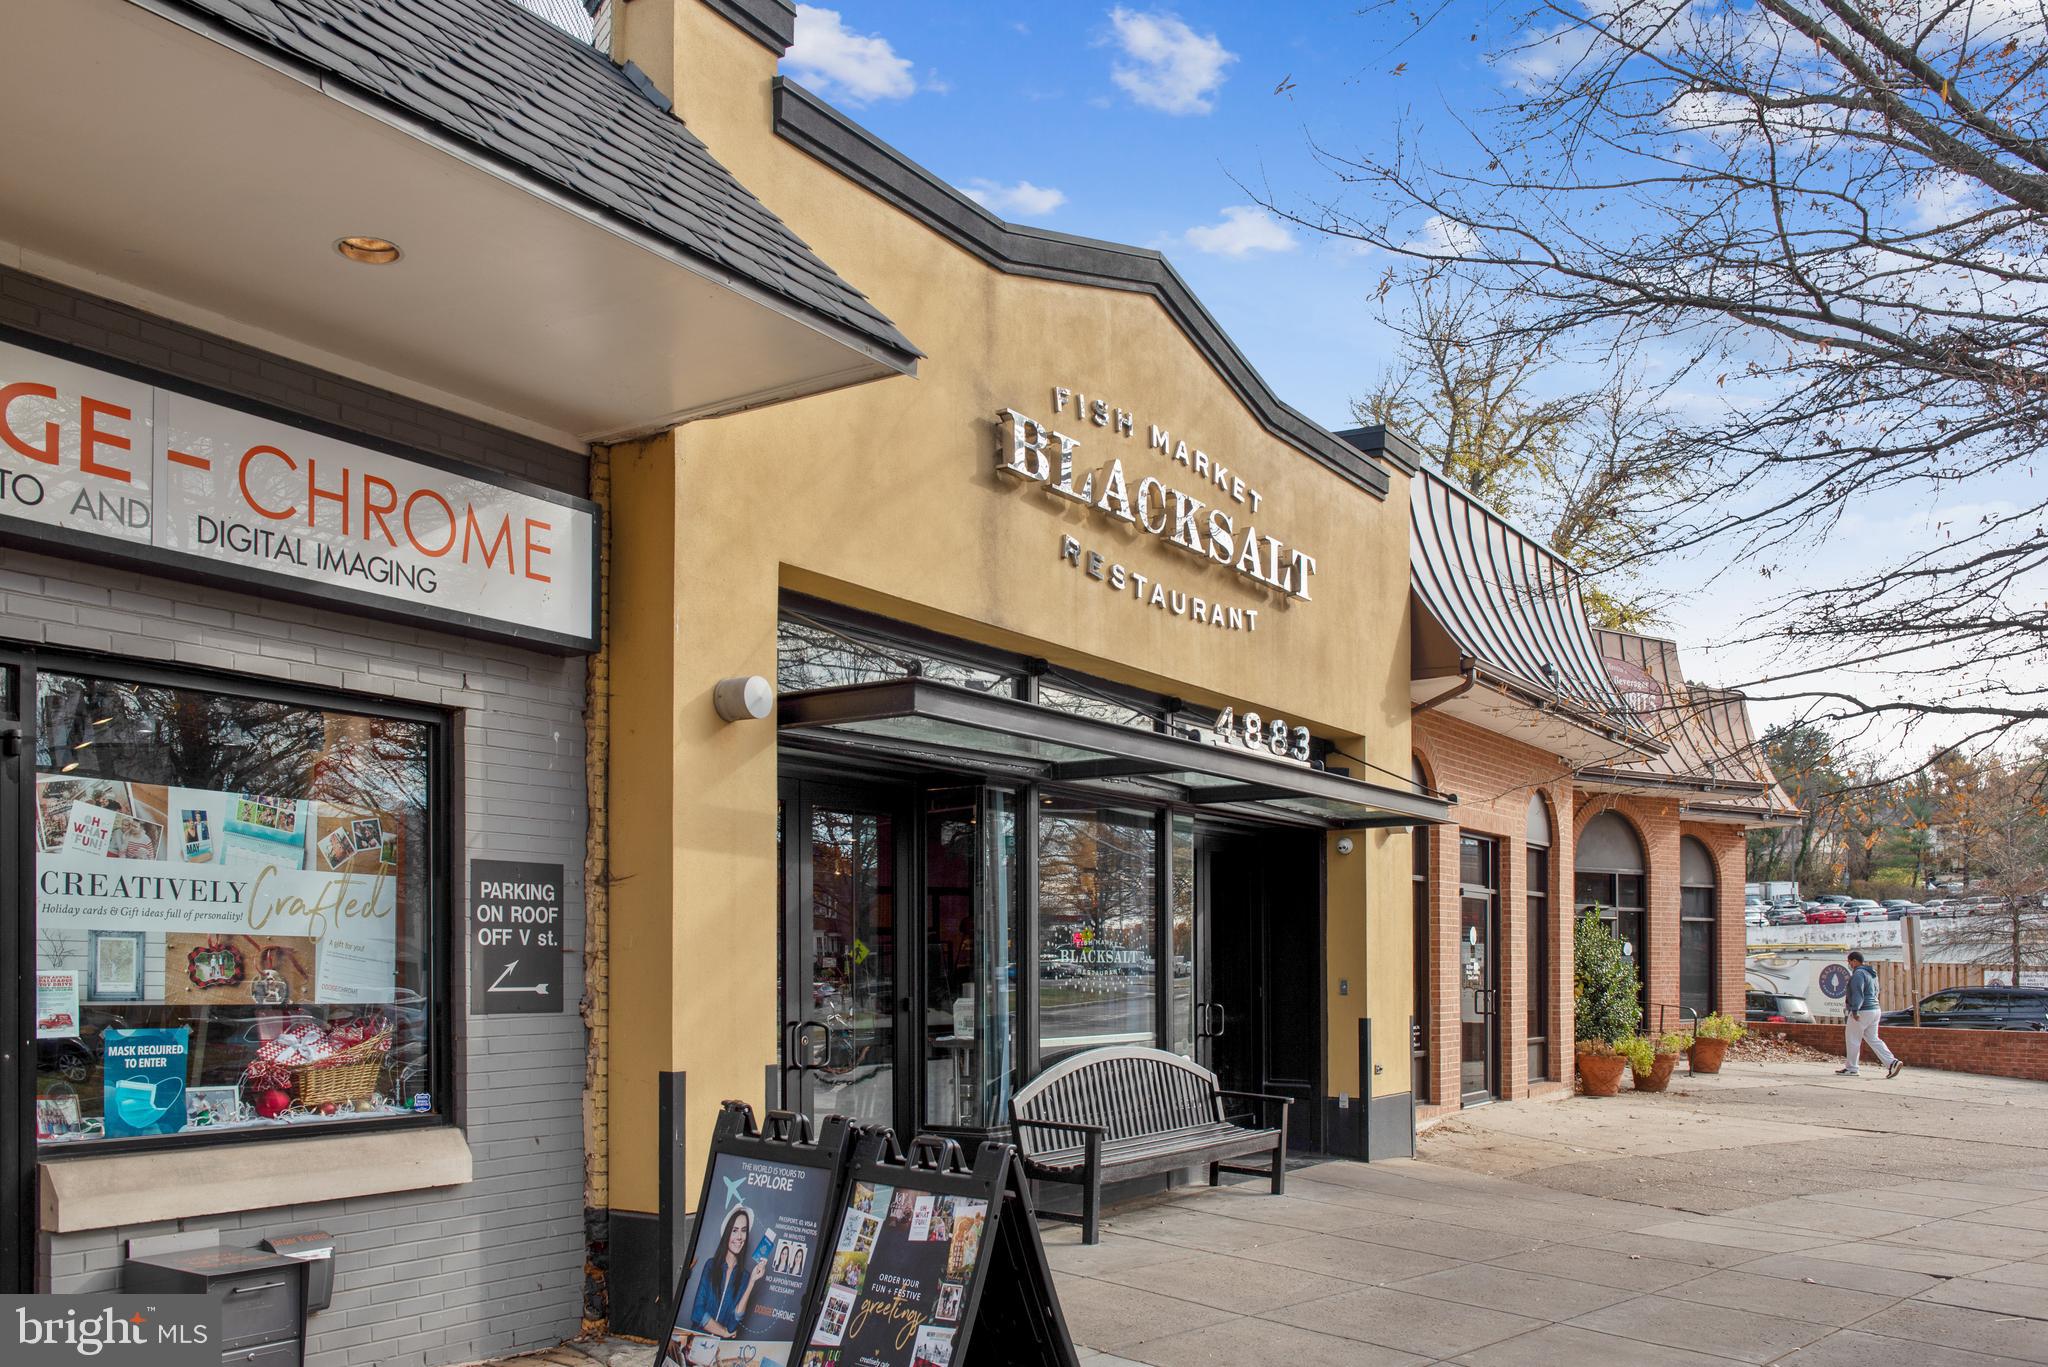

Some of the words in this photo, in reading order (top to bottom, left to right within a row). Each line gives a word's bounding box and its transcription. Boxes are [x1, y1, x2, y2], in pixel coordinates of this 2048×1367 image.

[1054, 386, 1133, 437] FISH
[1150, 424, 1263, 513] MARKET
[70, 487, 152, 529] AND
[996, 407, 1316, 602] BLACKSALT
[239, 445, 551, 583] CHROME
[198, 515, 307, 566] DIGITAL
[317, 542, 437, 594] IMAGING
[1061, 534, 1258, 631] RESTAURANT
[1213, 706, 1310, 761] 4883
[84, 815, 100, 827] OH
[73, 822, 108, 839] WHAT
[74, 833, 103, 850] FUN!
[186, 843, 200, 855] MAY
[40, 870, 248, 904] CREATIVELY
[248, 856, 392, 944] Crafted
[480, 881, 555, 902] PARKING
[41, 903, 80, 917] Holiday
[82, 905, 107, 916] cards
[110, 907, 118, 916] &
[120, 906, 139, 920] Gift
[142, 907, 164, 918] ideas
[165, 908, 181, 921] full
[183, 909, 193, 921] of
[194, 910, 243, 922] personality!
[477, 905, 503, 923] ON
[511, 906, 559, 924] ROOF
[478, 928, 512, 946] OFF
[519, 929, 531, 946] V
[537, 930, 558, 946] st.
[1060, 949, 1138, 964] BLACKSALT
[1077, 967, 1122, 976] RESTAURANT
[108, 1045, 136, 1056] MASK
[137, 1044, 184, 1056] REQUIRED
[124, 1058, 137, 1069] TO
[138, 1057, 167, 1068] ENTER
[742, 1162, 753, 1171] THE
[753, 1164, 773, 1174] WORLD
[773, 1167, 778, 1175] IS
[779, 1168, 797, 1178] YOURS
[797, 1170, 806, 1179] TO
[747, 1172, 794, 1191] EXPLORE
[801, 1227, 818, 1236] PHOTOS
[804, 1220, 814, 1228] VISA
[773, 1276, 803, 1288] APPOINTMENT
[879, 1273, 900, 1285] ORDER
[902, 1278, 920, 1288] YOUR
[872, 1283, 886, 1294] FUN
[893, 1287, 921, 1301] FESTIVE
[849, 1287, 928, 1350] greetings
